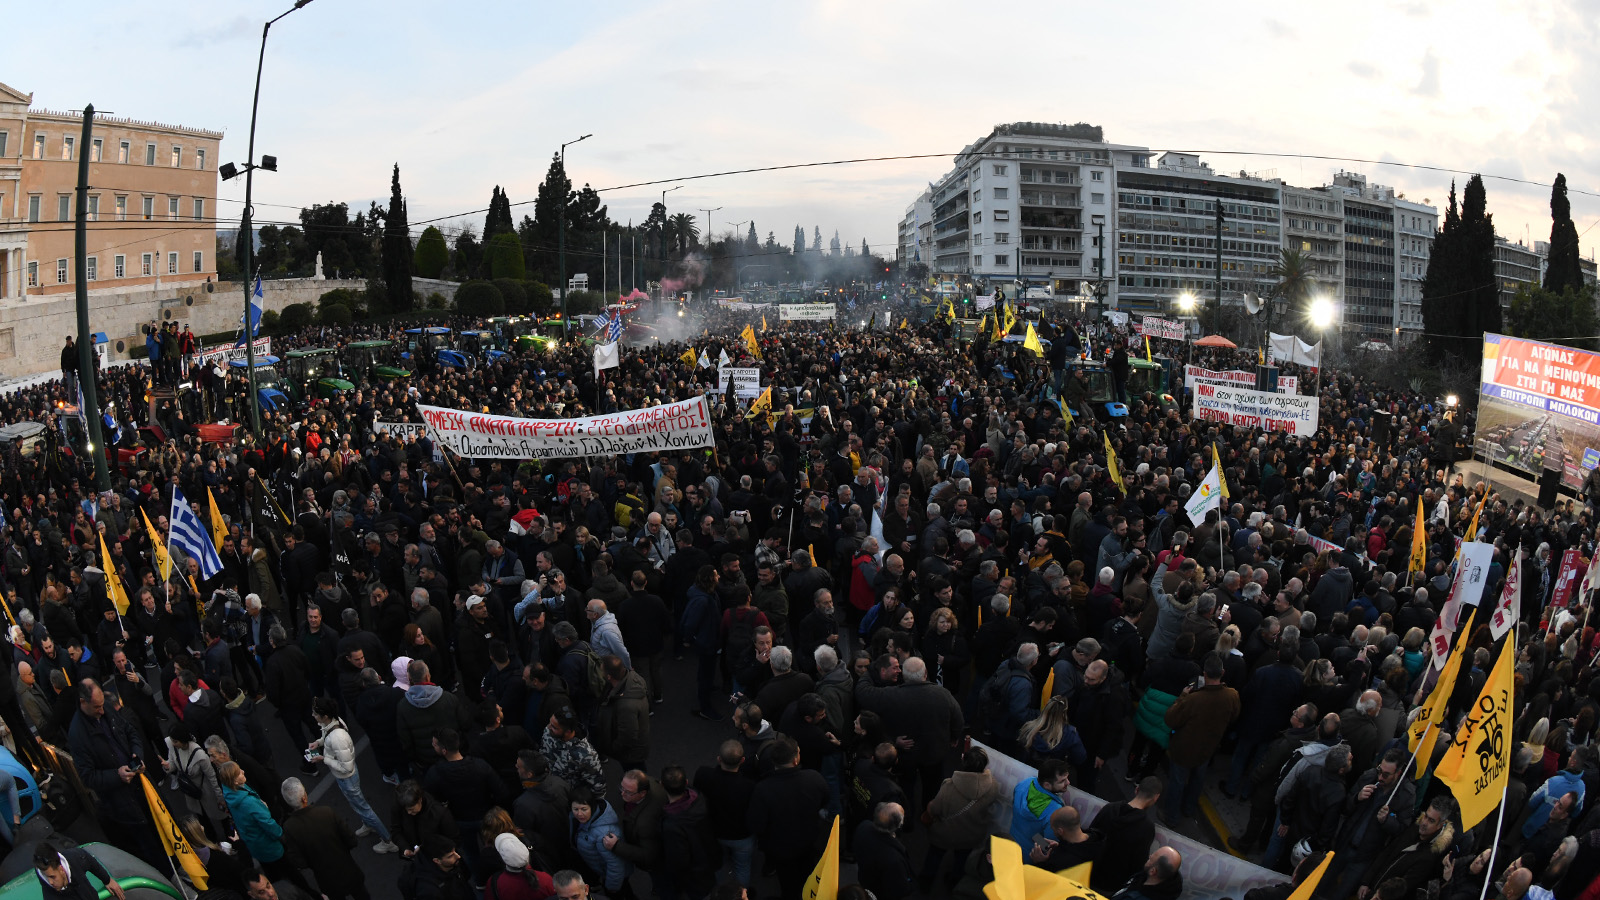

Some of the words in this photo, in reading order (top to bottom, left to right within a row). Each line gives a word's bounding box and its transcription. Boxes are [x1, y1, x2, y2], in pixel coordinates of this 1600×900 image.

[1501, 356, 1519, 370] ΓΙΑ
[1524, 362, 1540, 375] ΝΑ
[1531, 346, 1574, 365] ΑΓΩΝΑΣ
[1198, 384, 1215, 397] ΝΙΚΗ
[1516, 375, 1537, 390] ΣΤΗ
[1541, 381, 1556, 395] ΓΗ
[1560, 386, 1585, 402] ΜΑΣ
[626, 403, 692, 424] ΧΑΜΕΝΟΥ
[1500, 388, 1545, 410] ΕΠΙΤΡΟΠΗ
[1549, 401, 1599, 423] ΜΠΛΟΚΩΝ
[423, 410, 466, 431] ΑΜΕΣΗ
[1232, 413, 1261, 428] ΚΕΝΤΡΟ
[1264, 418, 1296, 434] ΠΕΙΑΙΑ
